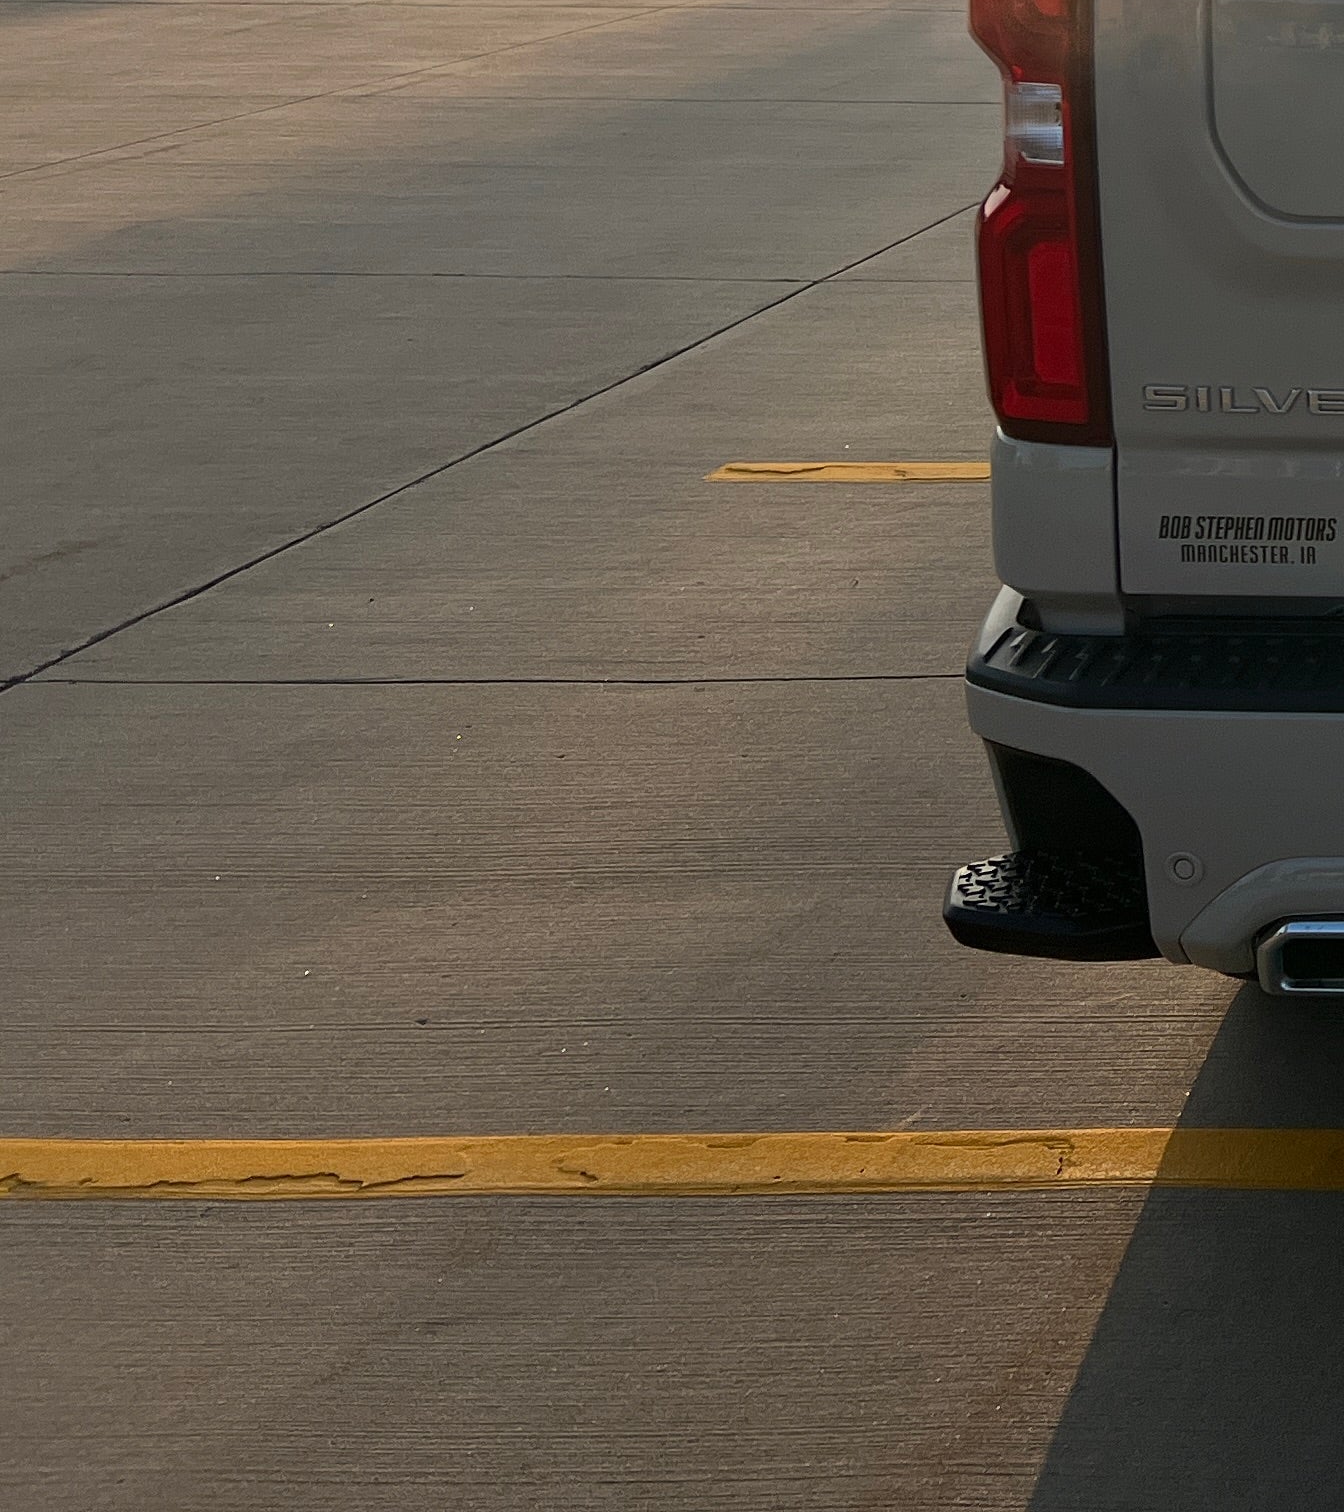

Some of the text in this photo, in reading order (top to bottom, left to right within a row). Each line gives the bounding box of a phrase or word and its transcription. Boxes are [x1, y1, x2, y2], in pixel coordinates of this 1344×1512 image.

[1158, 515, 1337, 541] BOB STEPHEN MOTORS
[1300, 546, 1316, 565] IA
